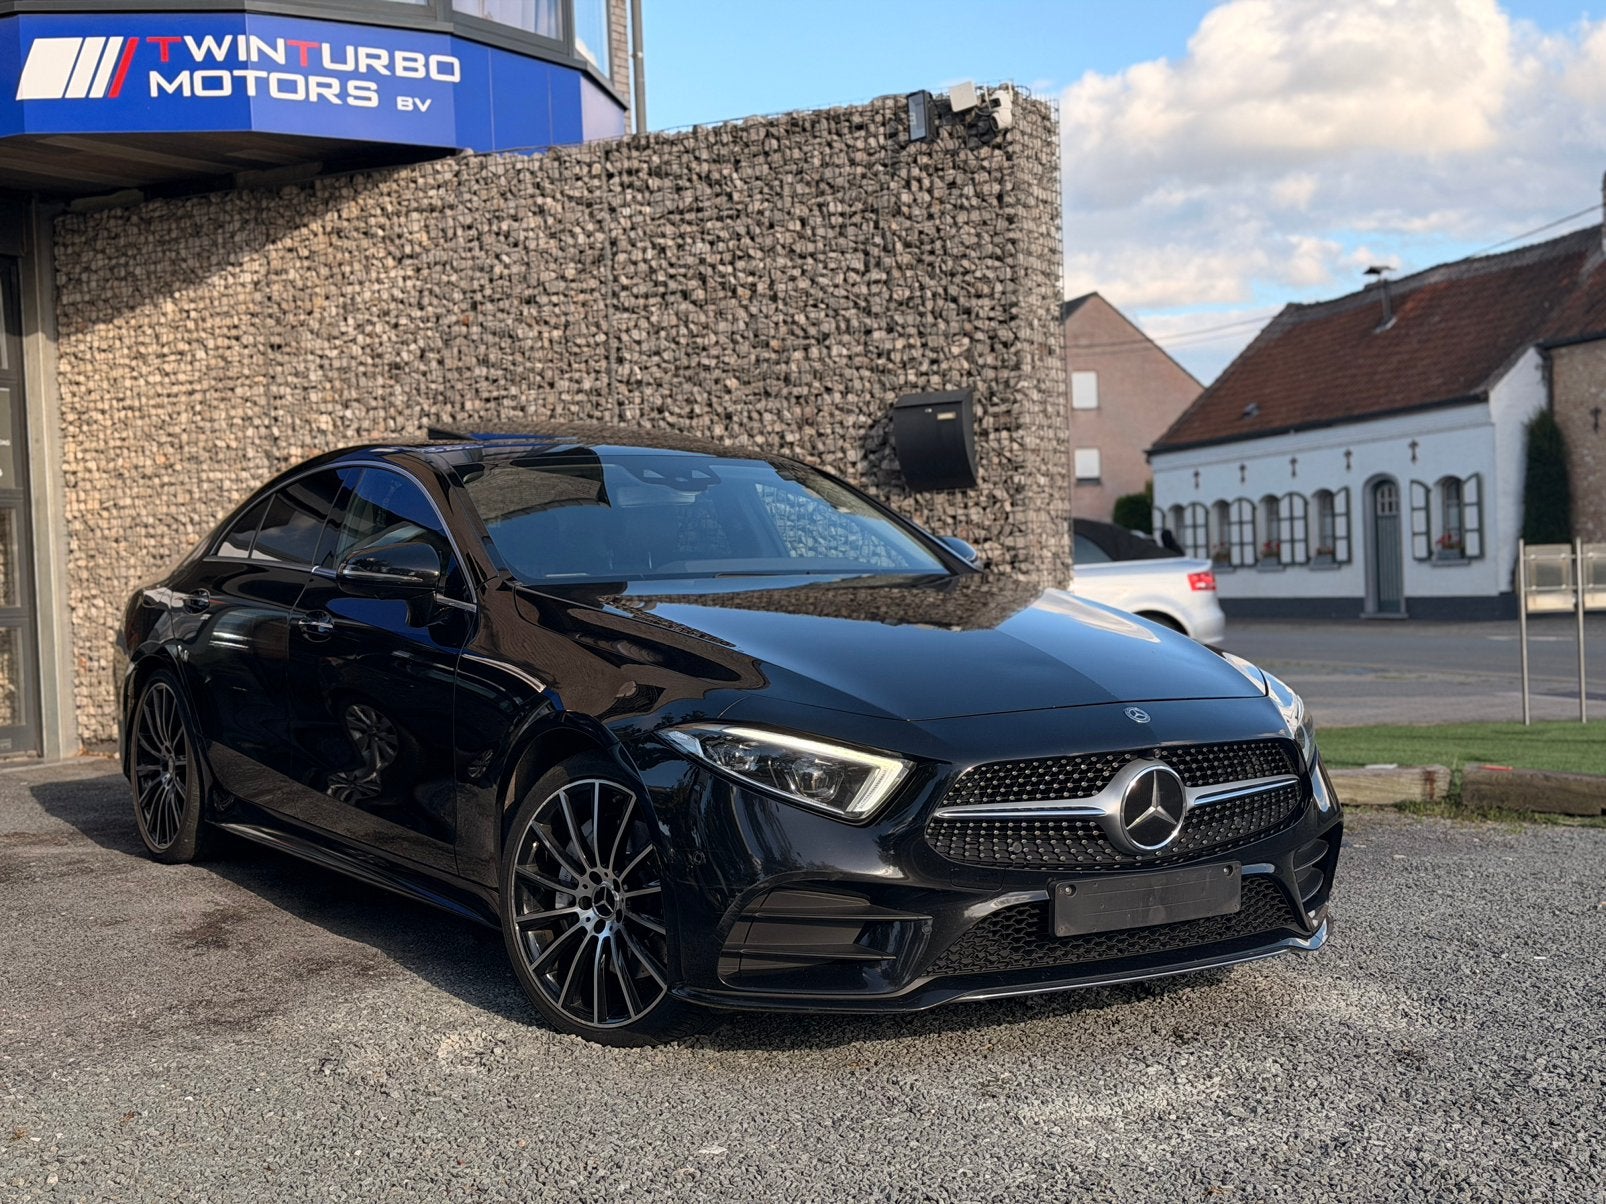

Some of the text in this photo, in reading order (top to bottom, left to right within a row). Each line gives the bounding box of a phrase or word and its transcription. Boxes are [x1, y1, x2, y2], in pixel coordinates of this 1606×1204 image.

[146, 34, 461, 83] TWINTURBO
[149, 69, 432, 113] MOTORS BV
